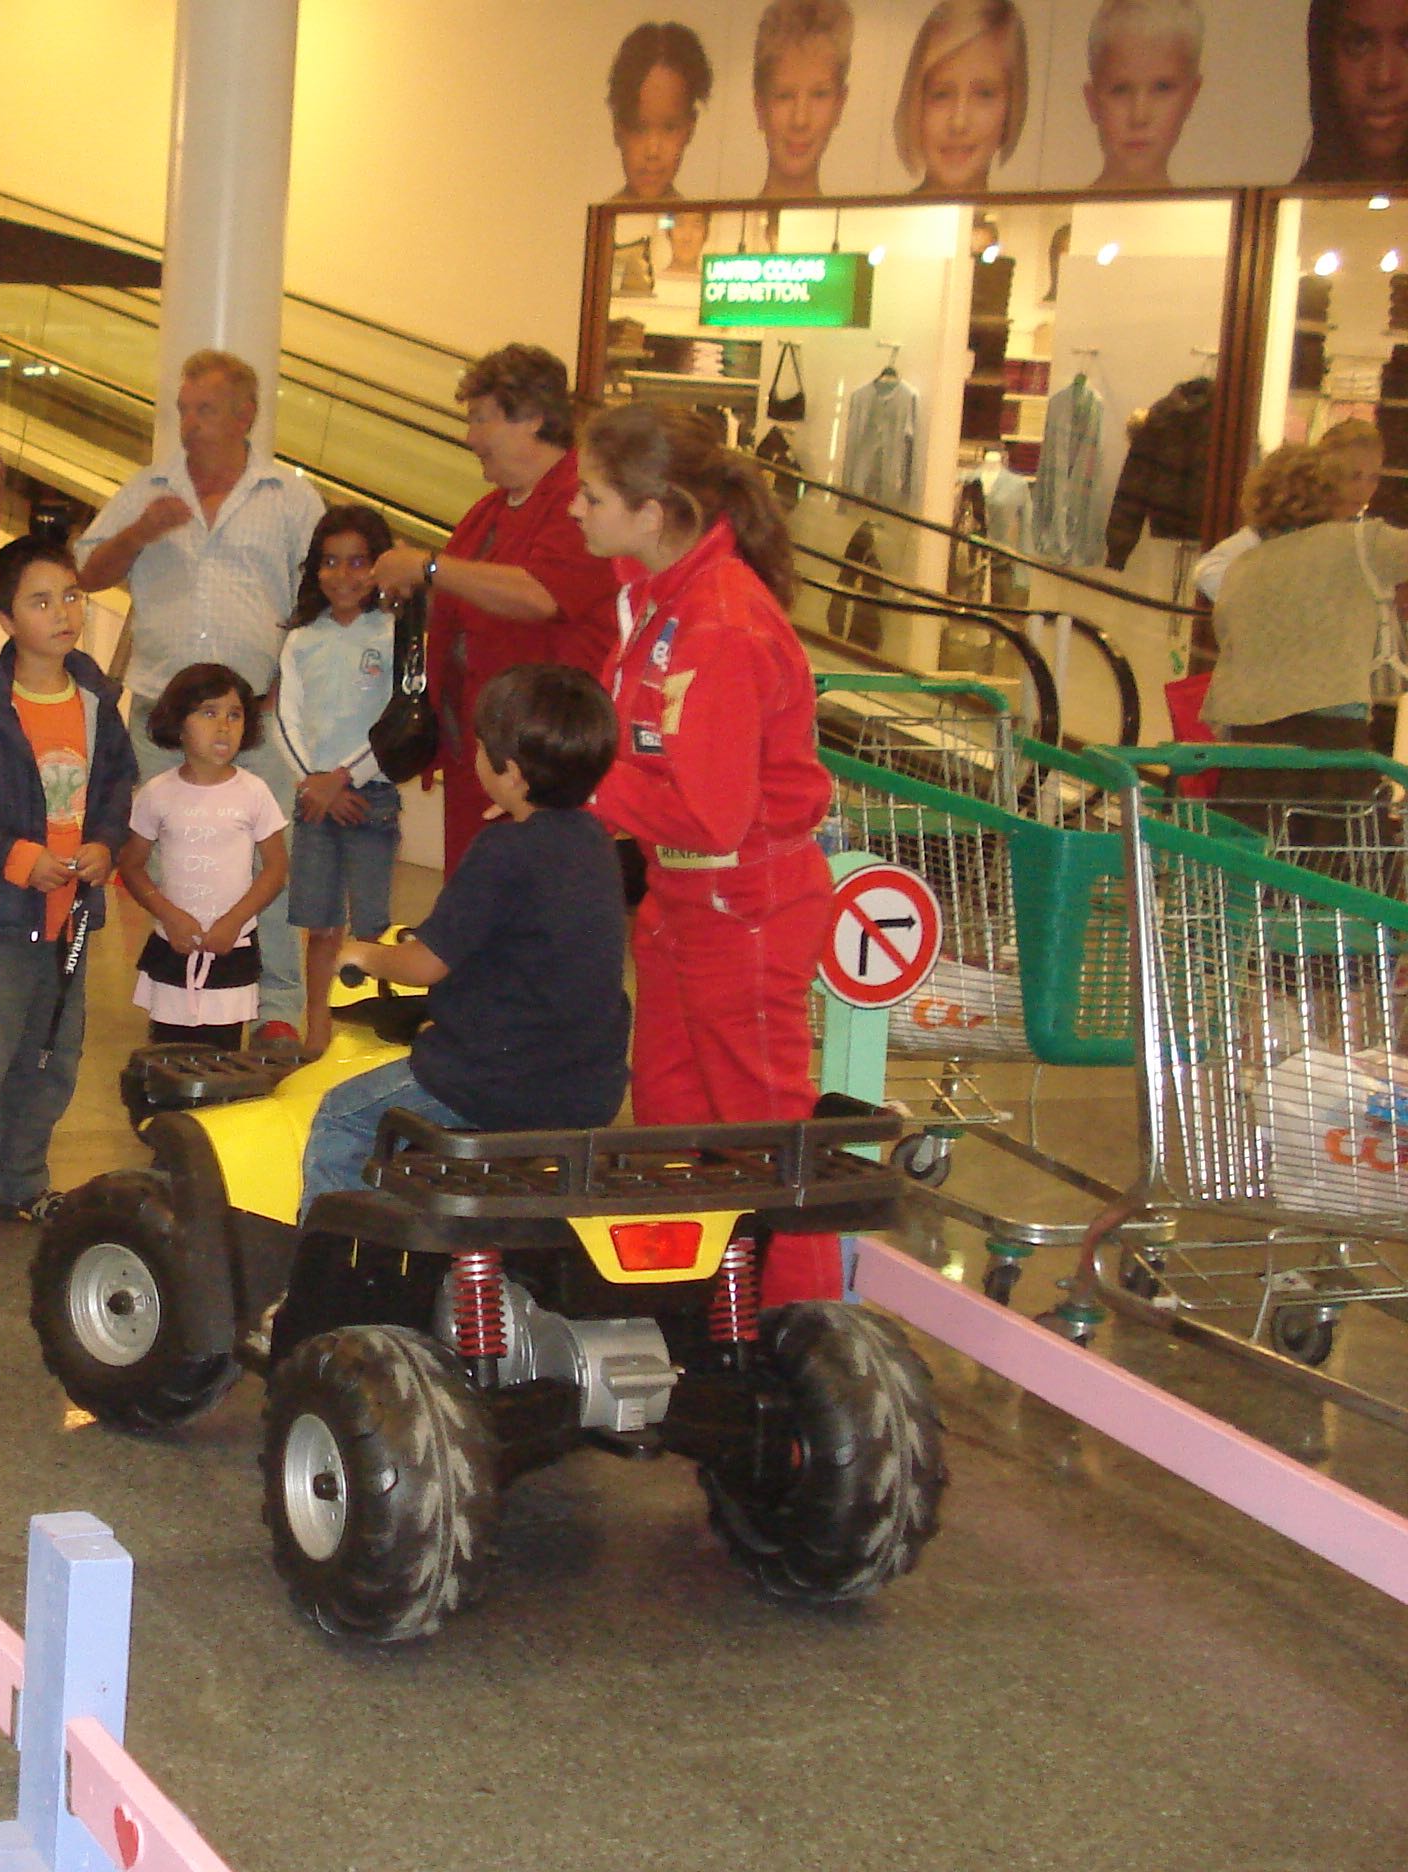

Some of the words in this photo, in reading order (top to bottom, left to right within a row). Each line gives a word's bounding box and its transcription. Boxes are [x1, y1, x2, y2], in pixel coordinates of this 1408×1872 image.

[706, 260, 762, 281] UNITED
[763, 259, 826, 282] COLORS
[705, 282, 726, 302] OF
[64, 910, 90, 975] POWERADE
